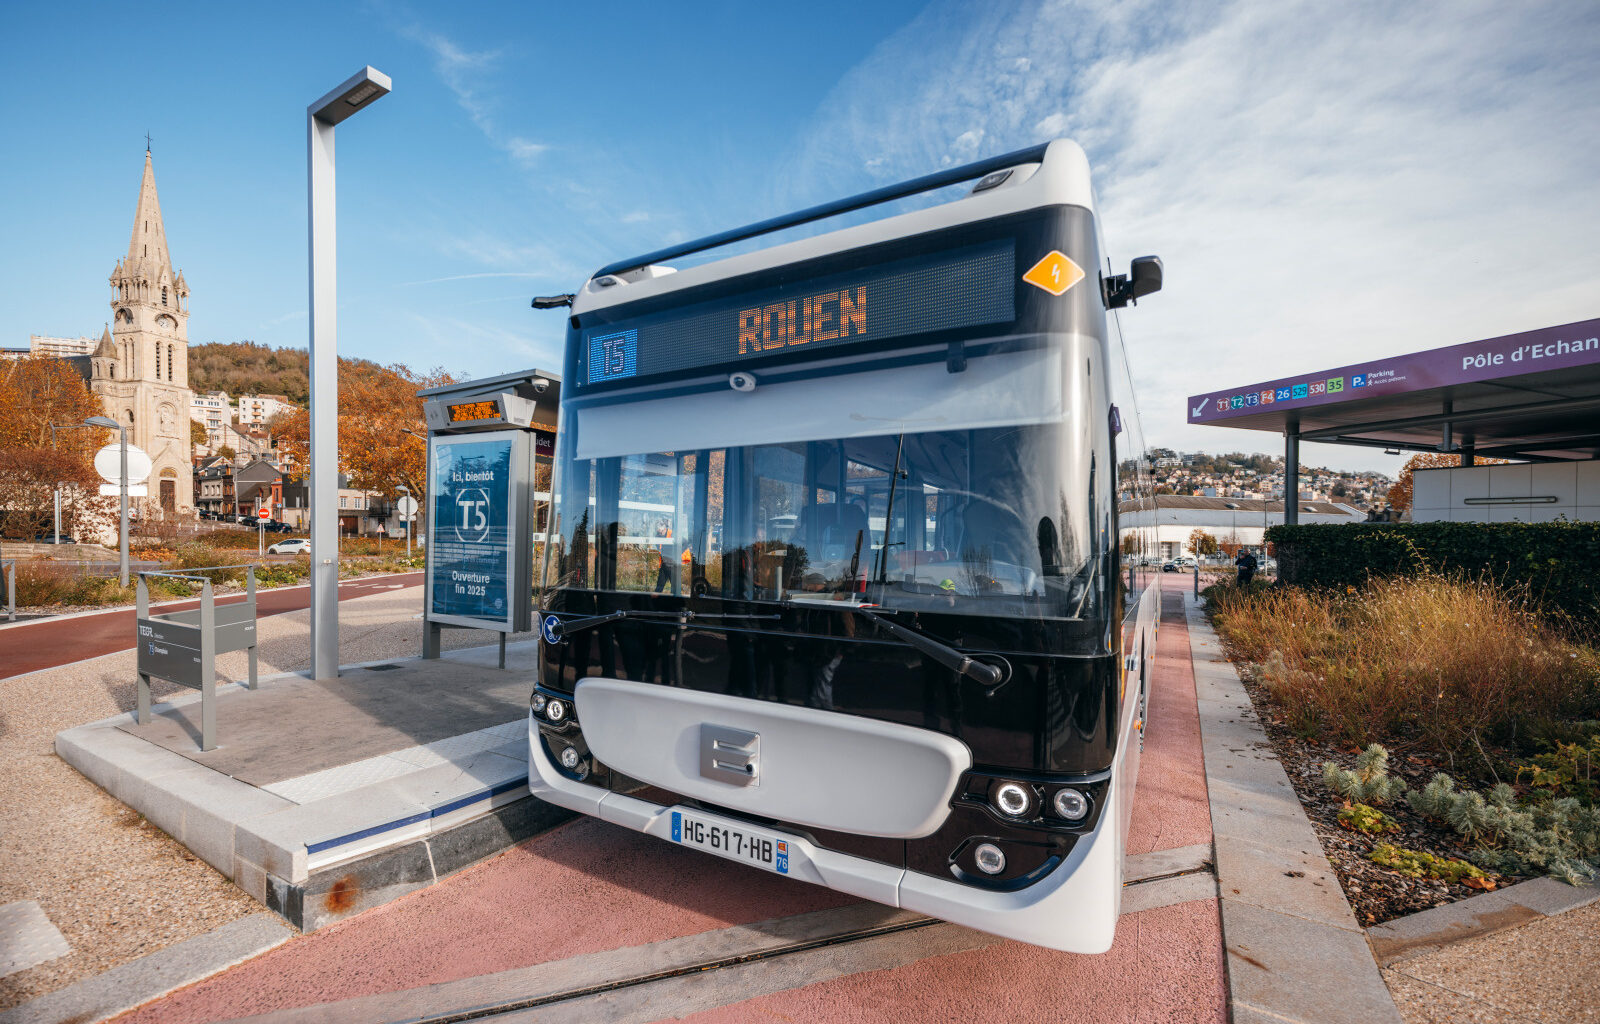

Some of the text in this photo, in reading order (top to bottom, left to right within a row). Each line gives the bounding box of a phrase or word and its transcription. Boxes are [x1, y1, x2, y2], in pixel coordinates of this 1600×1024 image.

[738, 286, 867, 355] ROUEN
[603, 339, 625, 373] T5
[1462, 352, 1504, 370] Pôle
[1368, 369, 1395, 379] Parking
[1218, 401, 1228, 409] T1
[1232, 398, 1243, 407] T2
[1247, 395, 1258, 405] T3
[1261, 392, 1273, 402] F4
[1277, 389, 1289, 399] 26
[1328, 380, 1342, 391] 35
[453, 470, 495, 483] Ici, bientôt
[458, 500, 487, 531] T5
[452, 570, 490, 584] Ouverture
[455, 583, 486, 597] fin 2025
[777, 857, 788, 869] 76
